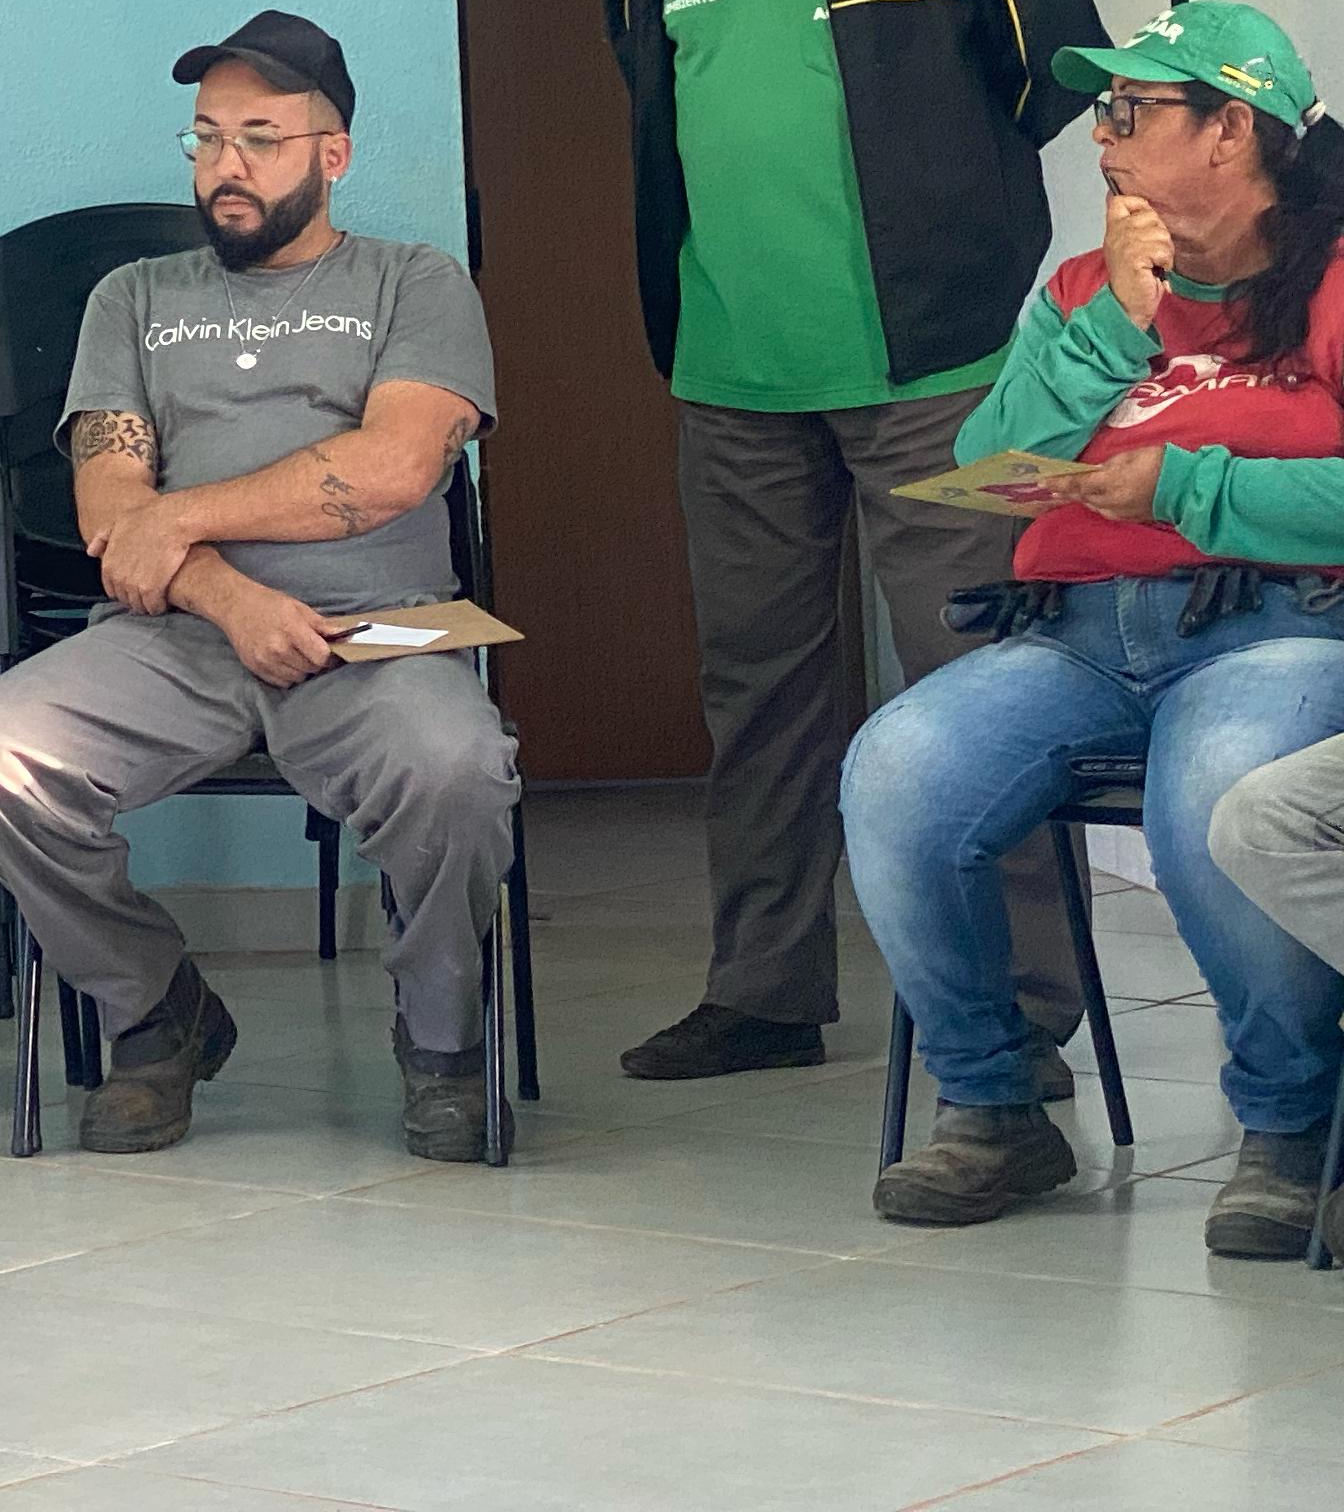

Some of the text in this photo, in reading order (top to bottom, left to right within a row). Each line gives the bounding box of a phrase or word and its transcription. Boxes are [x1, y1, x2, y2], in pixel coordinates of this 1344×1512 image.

[145, 309, 372, 351] Calvin Klein Jeans
